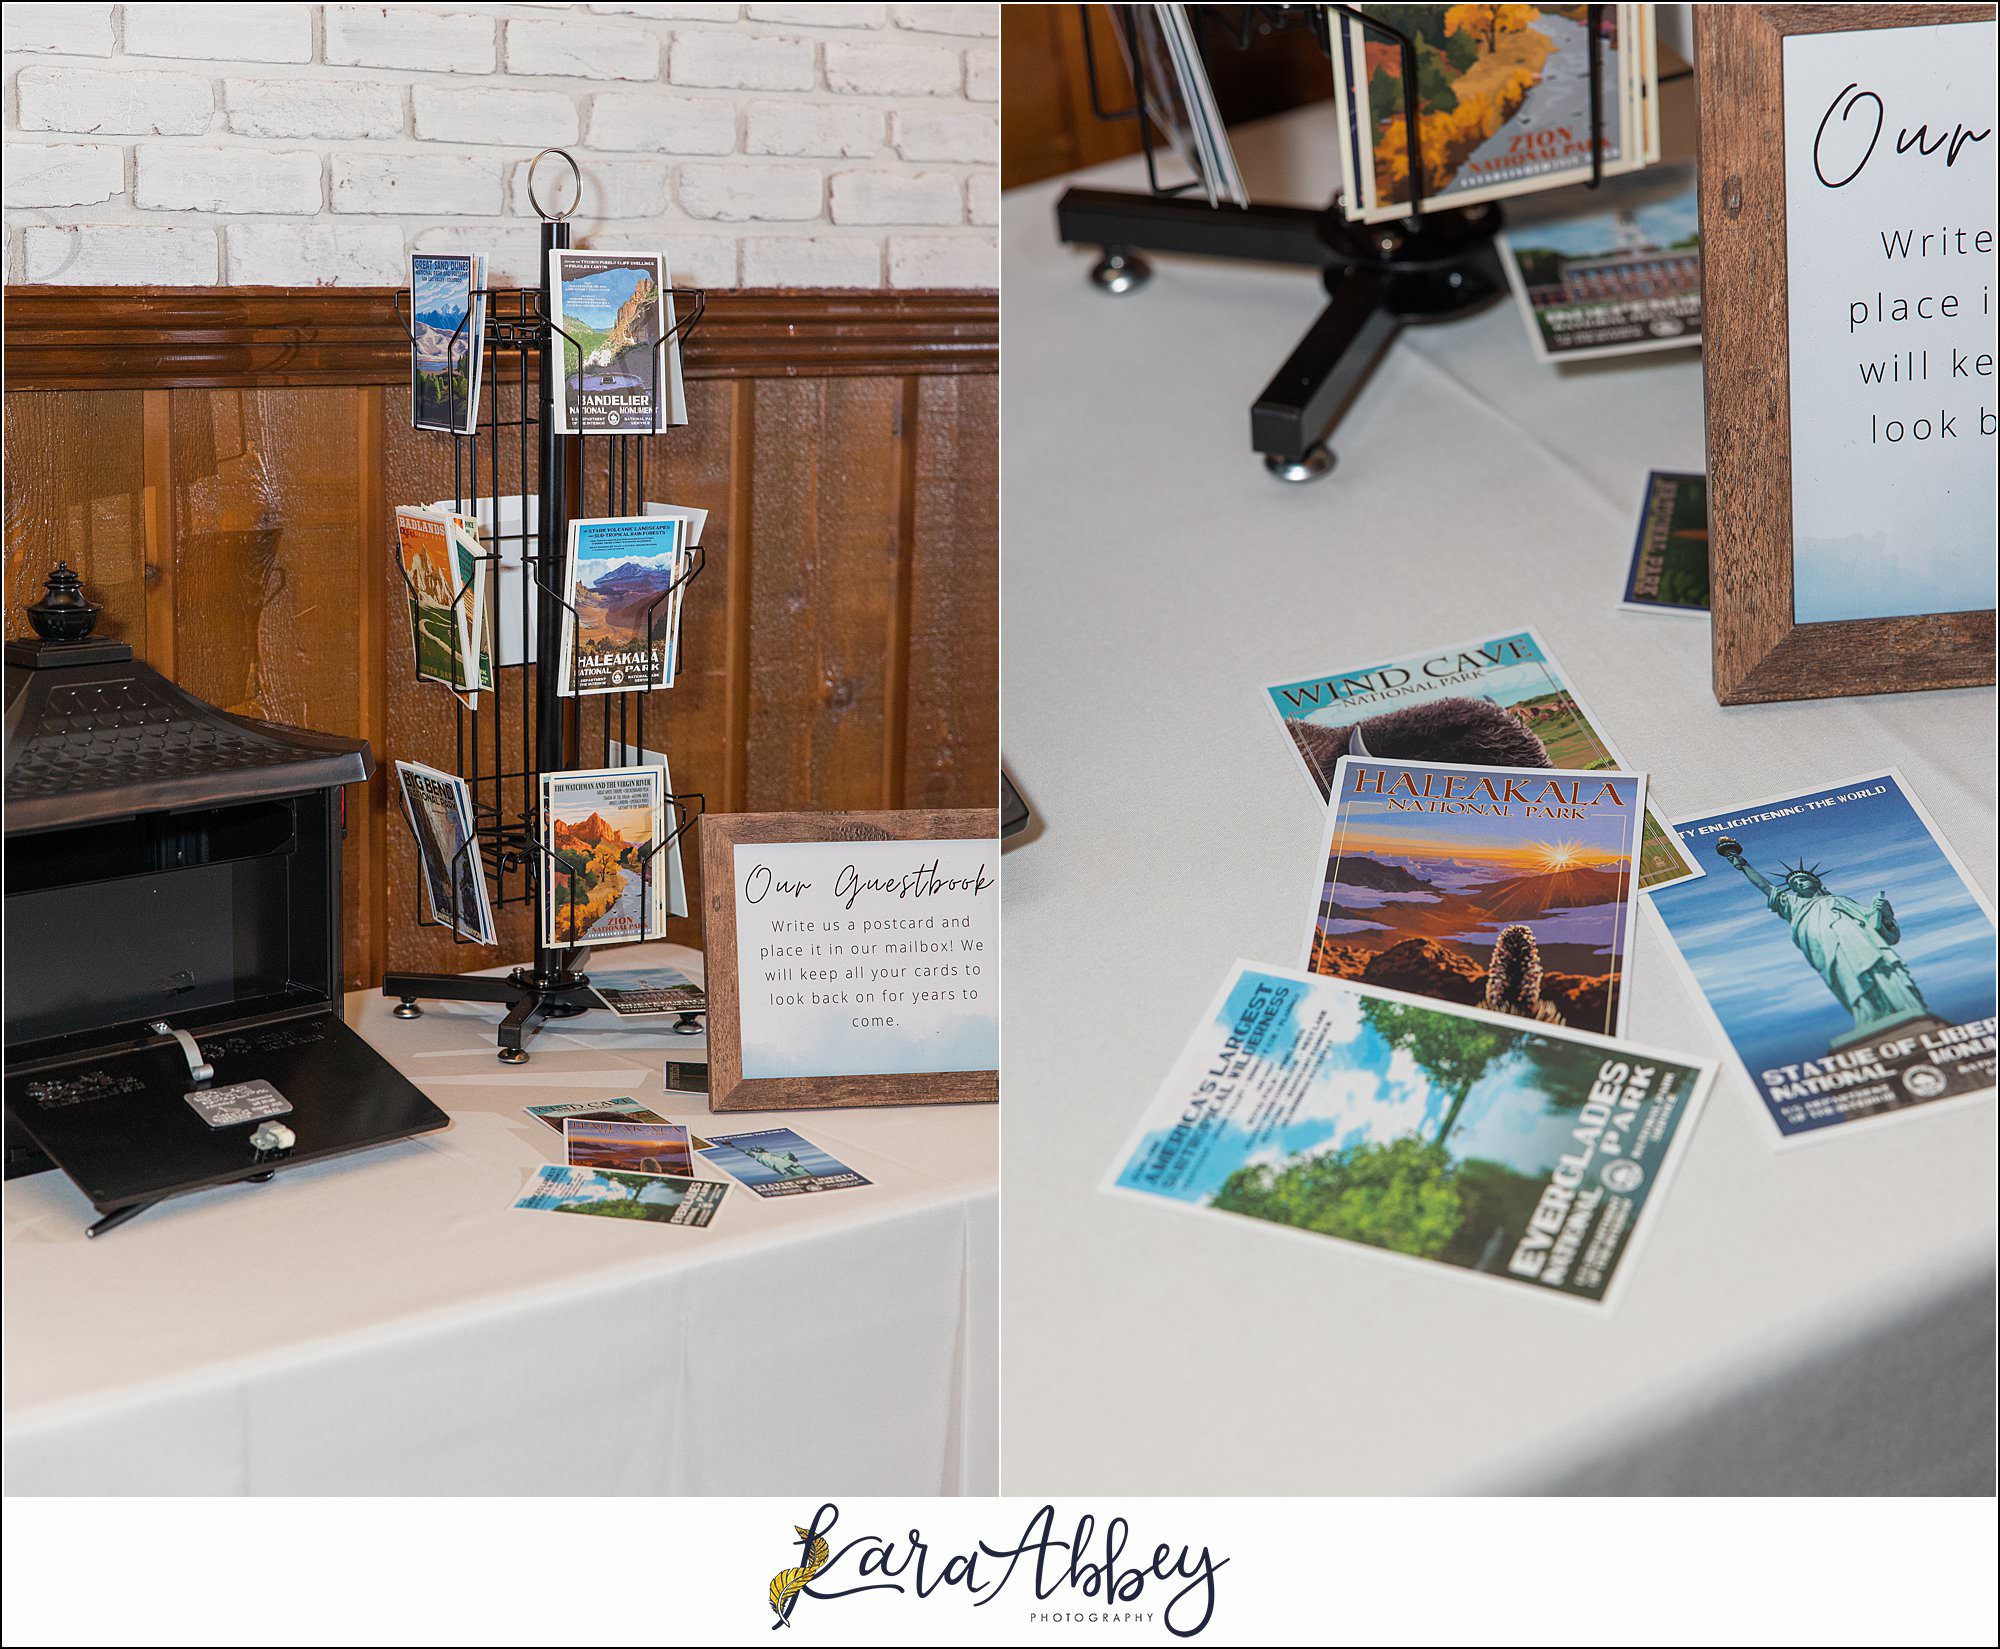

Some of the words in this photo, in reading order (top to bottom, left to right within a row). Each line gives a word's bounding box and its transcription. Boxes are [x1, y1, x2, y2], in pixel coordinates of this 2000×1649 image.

[1508, 127, 1572, 152] ZION
[1814, 82, 1992, 188] Our
[1469, 147, 1556, 173] NATIONAL
[1881, 226, 1993, 260] Write
[415, 260, 432, 270] GREAT
[434, 260, 449, 270] SAND
[451, 260, 469, 271] DUNES
[1850, 292, 1959, 334] place
[1860, 350, 1927, 384] will
[1952, 348, 1994, 378] ke
[578, 395, 649, 406] BANDELIER
[1872, 410, 1958, 444] look
[399, 516, 445, 536] BADLANDS
[575, 667, 612, 676] ATIONAL
[625, 664, 659, 672] PARK
[1282, 667, 1410, 709] WIND
[1422, 638, 1533, 678] CAVE
[1344, 680, 1438, 708] NATIONAL
[1440, 668, 1488, 687] PARK
[402, 770, 424, 791] BIG
[424, 777, 455, 800] BEND
[554, 784, 564, 792] THE
[565, 783, 594, 791] WATCHMAN
[607, 781, 617, 789] THE
[1354, 768, 1626, 807] HALEAKALA
[1387, 798, 1514, 816] NATIONAL
[1526, 807, 1588, 820] PARK
[1698, 806, 1805, 836] ENLIGHTENING
[1806, 797, 1837, 811] THE
[1837, 785, 1887, 804] WORLD
[745, 864, 812, 904] Our
[834, 859, 995, 910] Guestbook
[592, 925, 628, 933] NATIONAL
[608, 916, 633, 926] ZION
[771, 919, 815, 933] Write
[822, 922, 840, 932] us
[848, 922, 856, 932] a
[863, 916, 934, 932] postcard
[942, 915, 970, 929] and
[760, 944, 803, 960] place
[811, 944, 822, 956] it
[829, 943, 844, 956] in
[851, 942, 878, 955] our
[885, 940, 954, 954] mailbox!
[961, 940, 984, 952] We
[765, 968, 793, 982] will
[800, 968, 838, 983] keep
[845, 966, 864, 980] all
[871, 966, 907, 982] your
[914, 963, 958, 978] cards
[965, 964, 981, 976] to
[770, 991, 804, 1006] look
[812, 991, 848, 1005] back
[856, 992, 874, 1004] on
[882, 989, 906, 1003] for
[912, 988, 956, 1005] years
[963, 988, 978, 1001] to
[852, 1015, 900, 1028] come.
[1207, 981, 1276, 1076] LARGEST
[1226, 985, 1291, 1080] WILDERNESS
[1762, 1047, 1878, 1087] STATUE
[1879, 1037, 1916, 1060] OF
[1769, 1062, 1898, 1103] NATIONAL
[1505, 1057, 1634, 1279] EVERGLADES
[1538, 1182, 1606, 1286] NATIONAL
[1597, 1063, 1657, 1156] PARK
